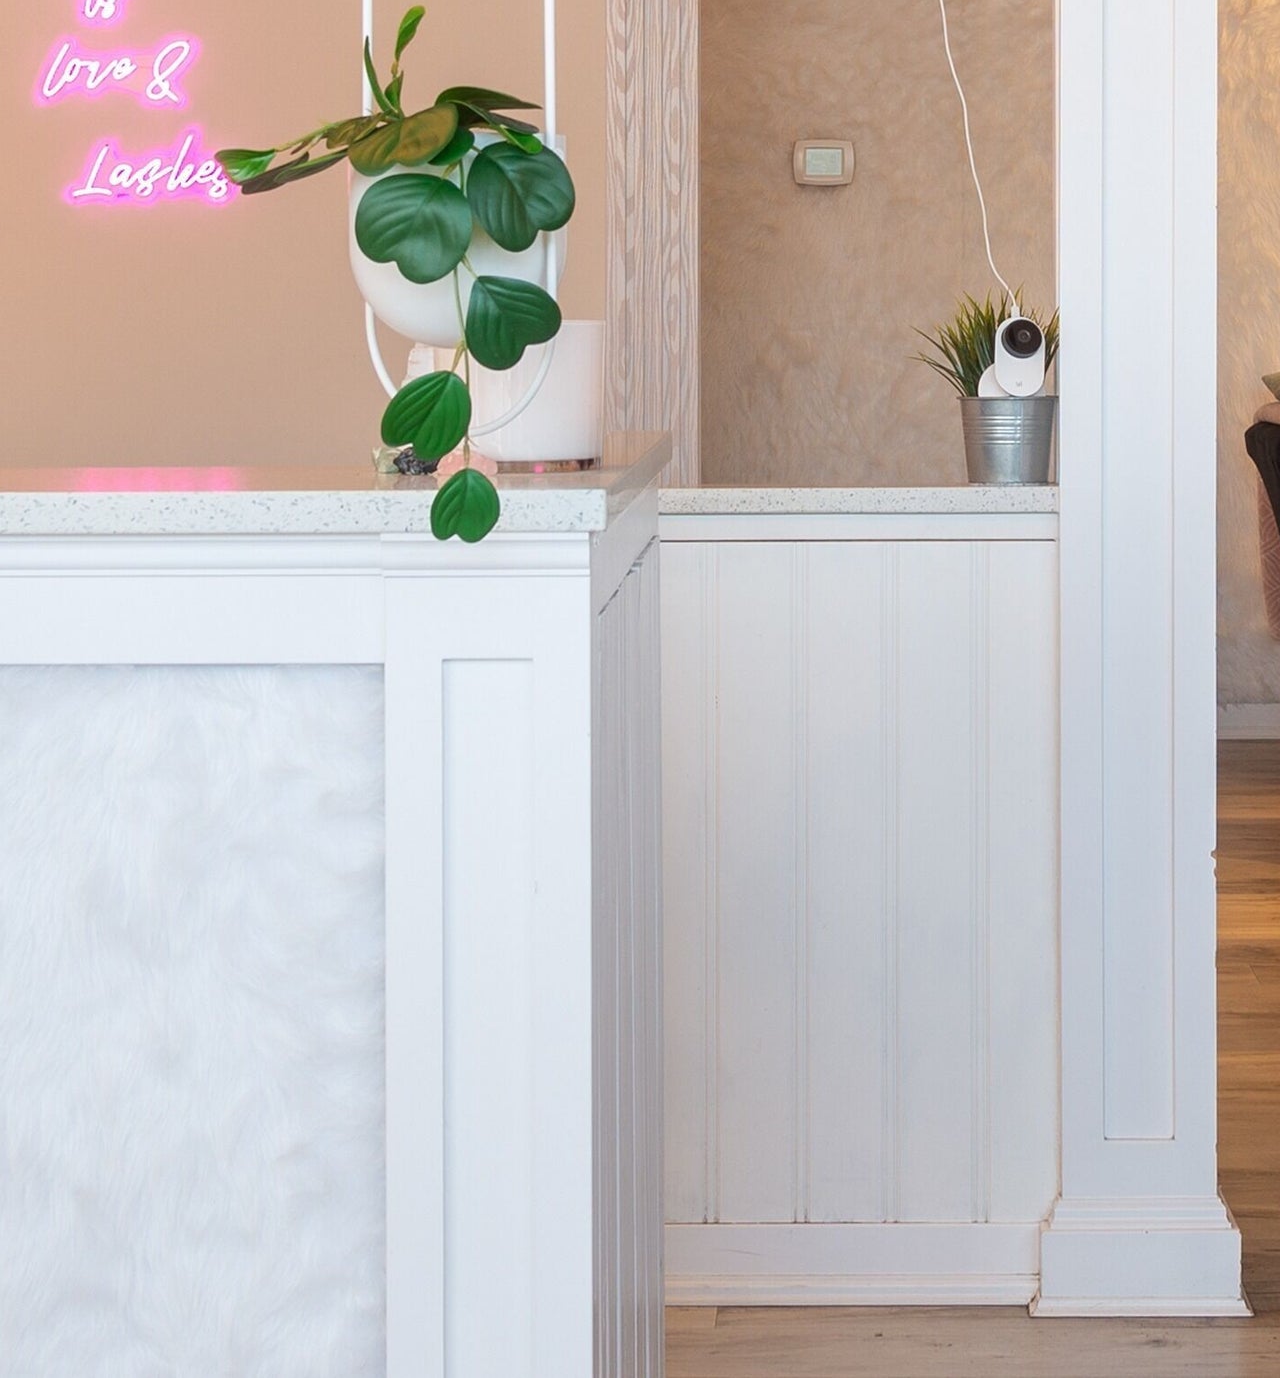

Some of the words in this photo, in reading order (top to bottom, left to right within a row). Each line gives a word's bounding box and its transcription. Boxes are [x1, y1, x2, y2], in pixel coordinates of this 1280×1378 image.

[42, 42, 138, 99] love
[145, 40, 191, 103] &
[72, 133, 228, 199] Lashes
